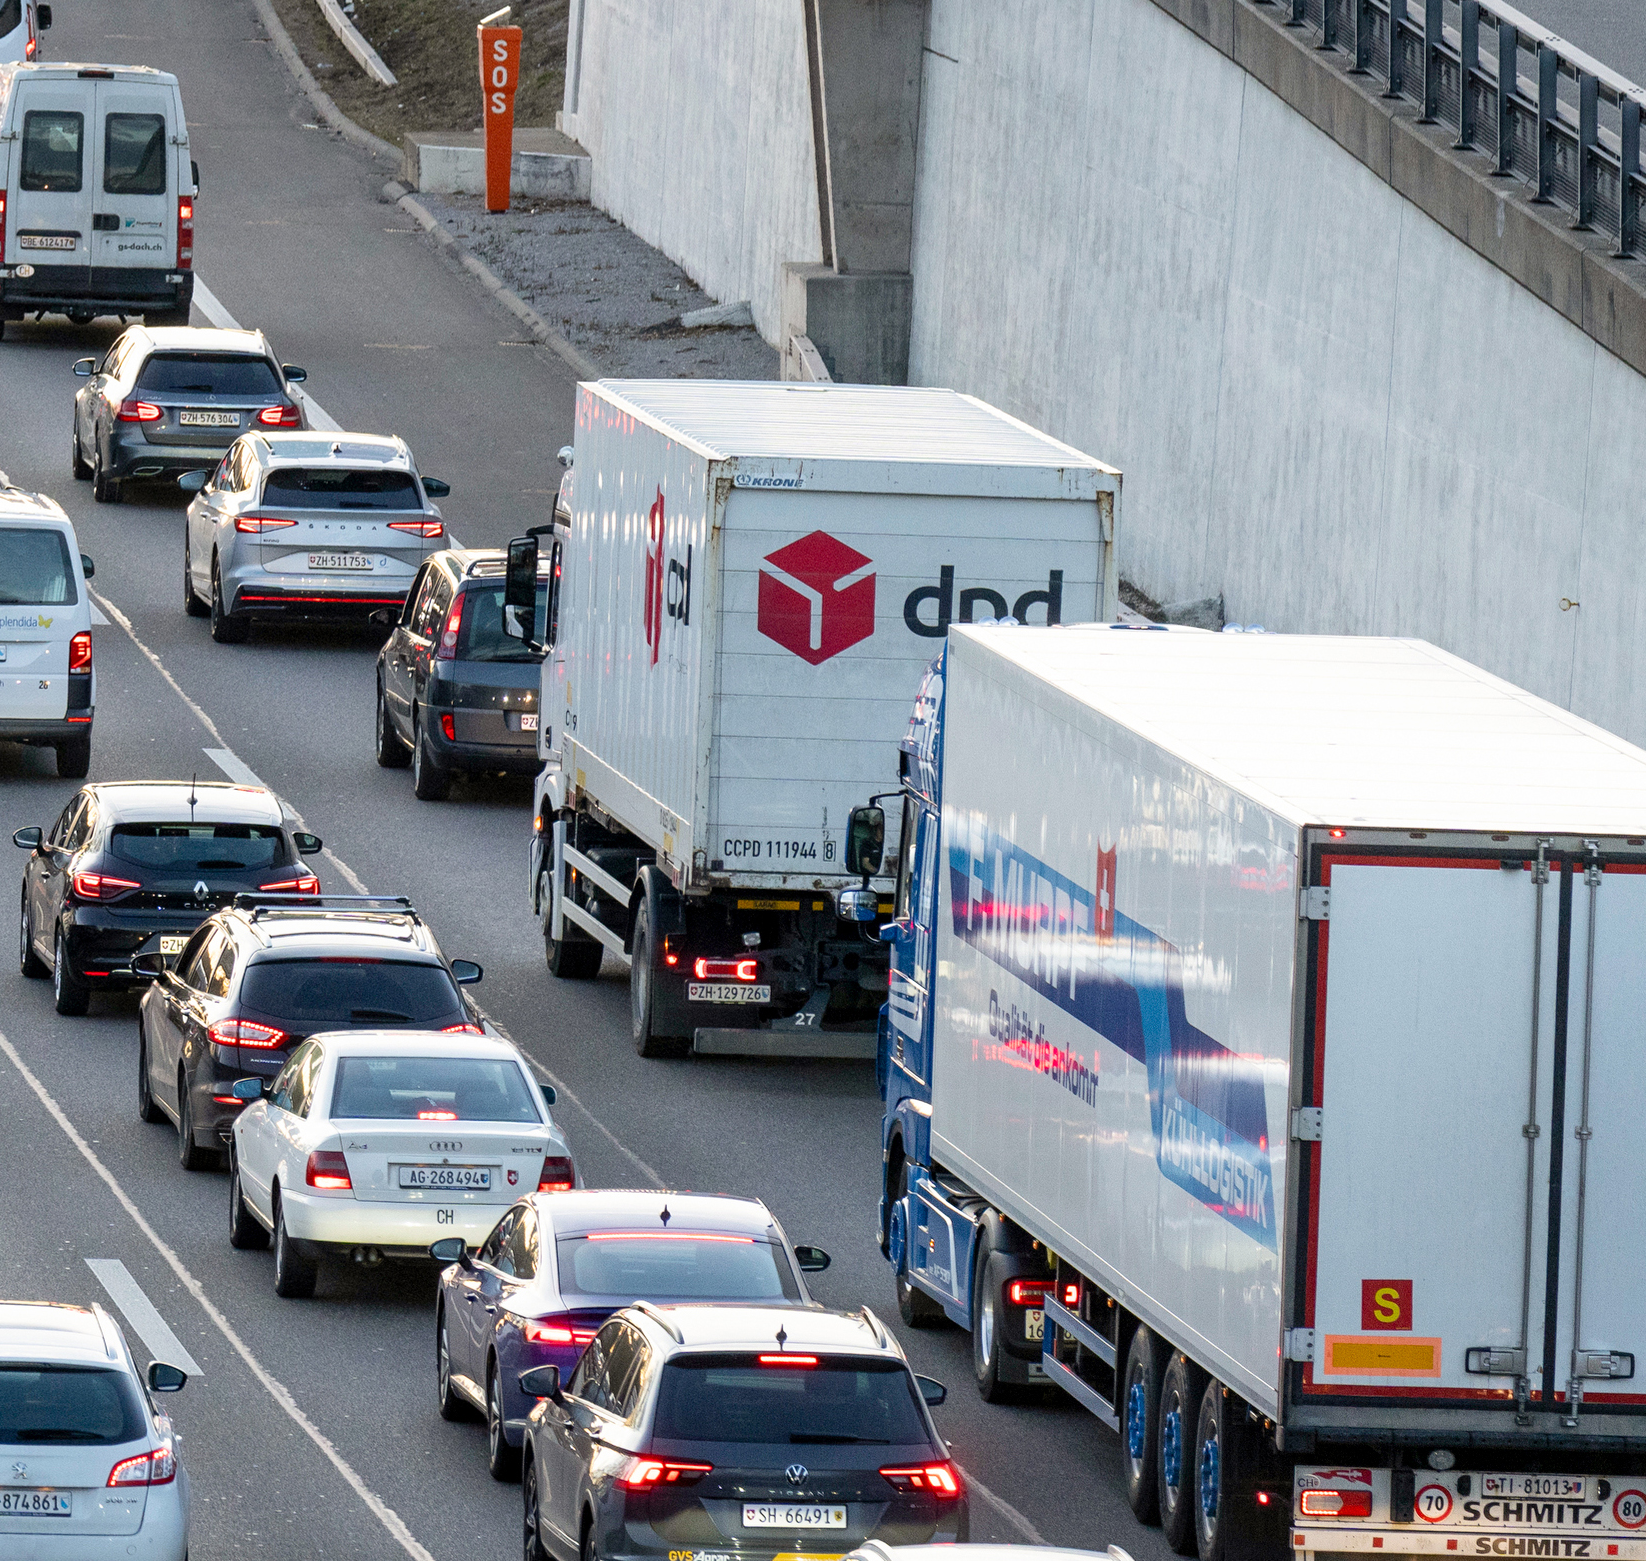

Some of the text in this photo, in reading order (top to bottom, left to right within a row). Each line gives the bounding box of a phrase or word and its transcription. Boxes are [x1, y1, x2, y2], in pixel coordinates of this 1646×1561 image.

[491, 39, 509, 115] SOS
[118, 242, 163, 252] gs-dach.ch
[19, 266, 30, 276] CH
[752, 477, 804, 488] KRONE
[724, 839, 761, 858] CCPD
[767, 841, 817, 859] 111944
[795, 1013, 816, 1026] 27
[1160, 1097, 1269, 1229] KÜHLLOGISTIK
[436, 1209, 454, 1225] CH
[1373, 1287, 1401, 1323] S
[1297, 1477, 1315, 1488] CH
[1425, 1495, 1445, 1512] 70
[1622, 1501, 1642, 1518] 80
[1462, 1500, 1604, 1526] SCHMITZ
[1475, 1537, 1591, 1557] SCHMITZ
